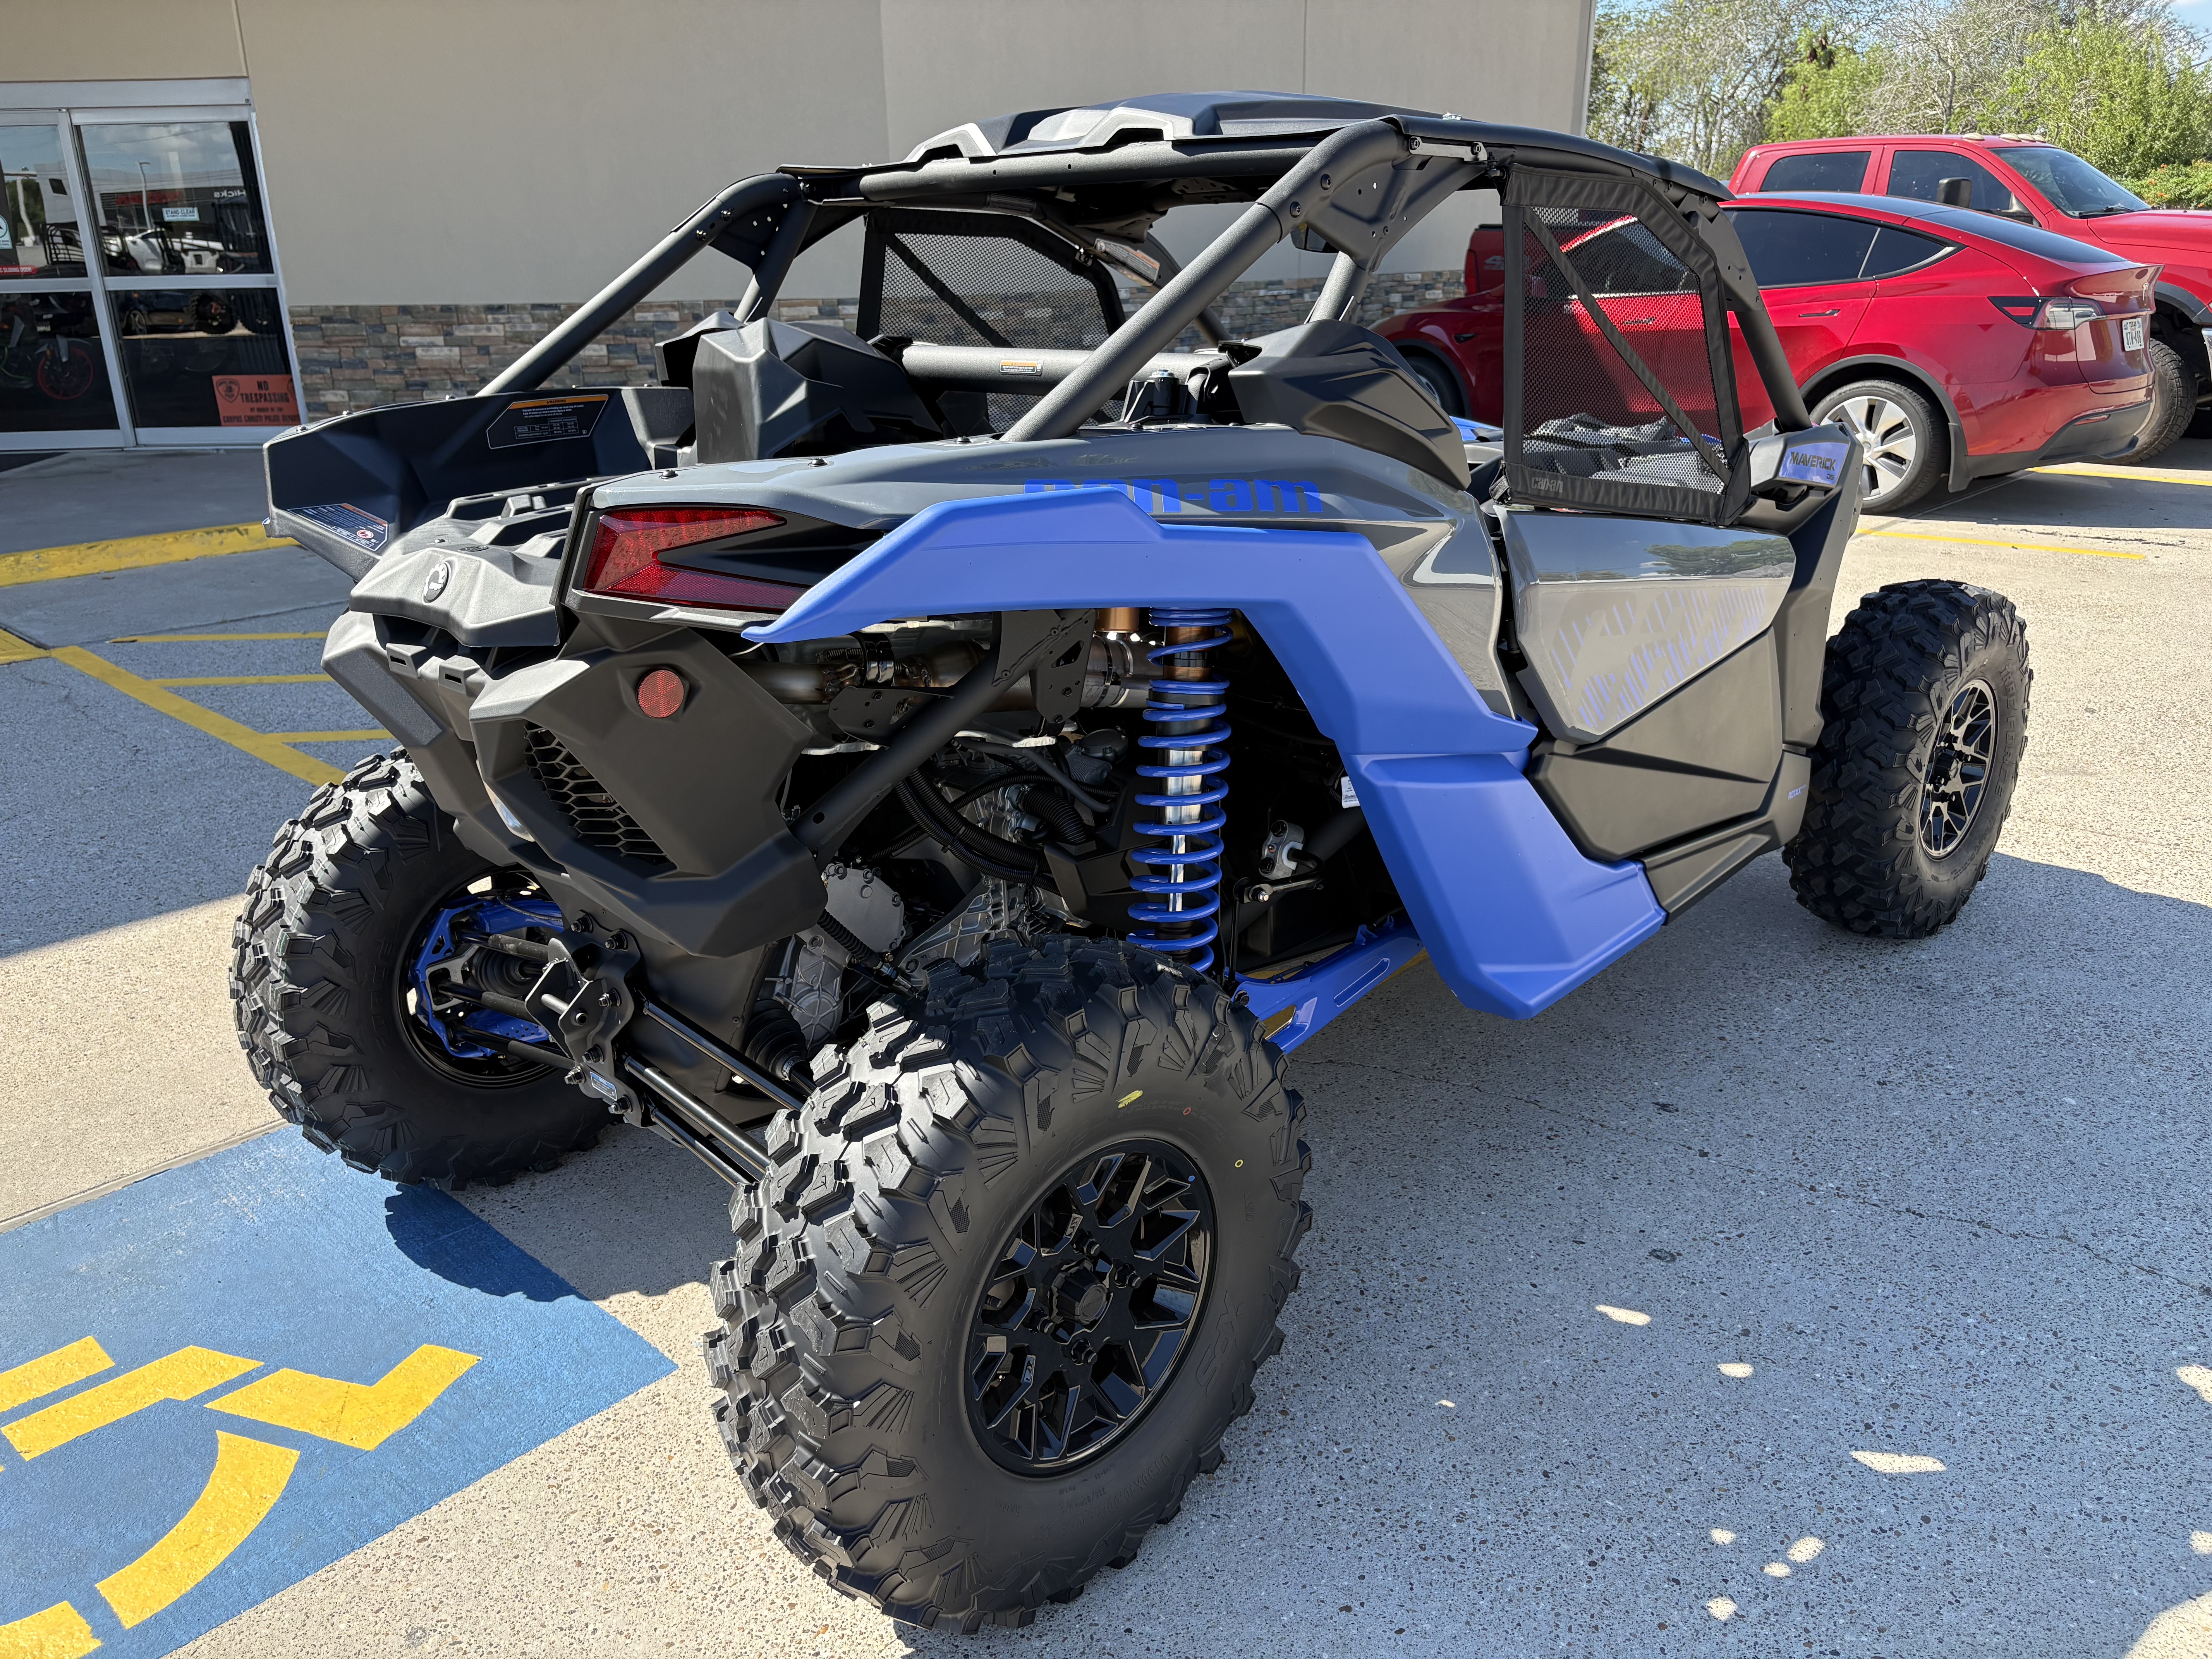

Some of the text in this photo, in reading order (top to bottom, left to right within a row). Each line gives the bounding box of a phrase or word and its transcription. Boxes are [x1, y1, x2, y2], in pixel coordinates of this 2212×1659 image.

[257, 381, 269, 391] NO
[240, 393, 290, 403] TRESPASSING
[1790, 452, 1837, 471] MAVERICK
[1995, 715, 2016, 797] FORCE
